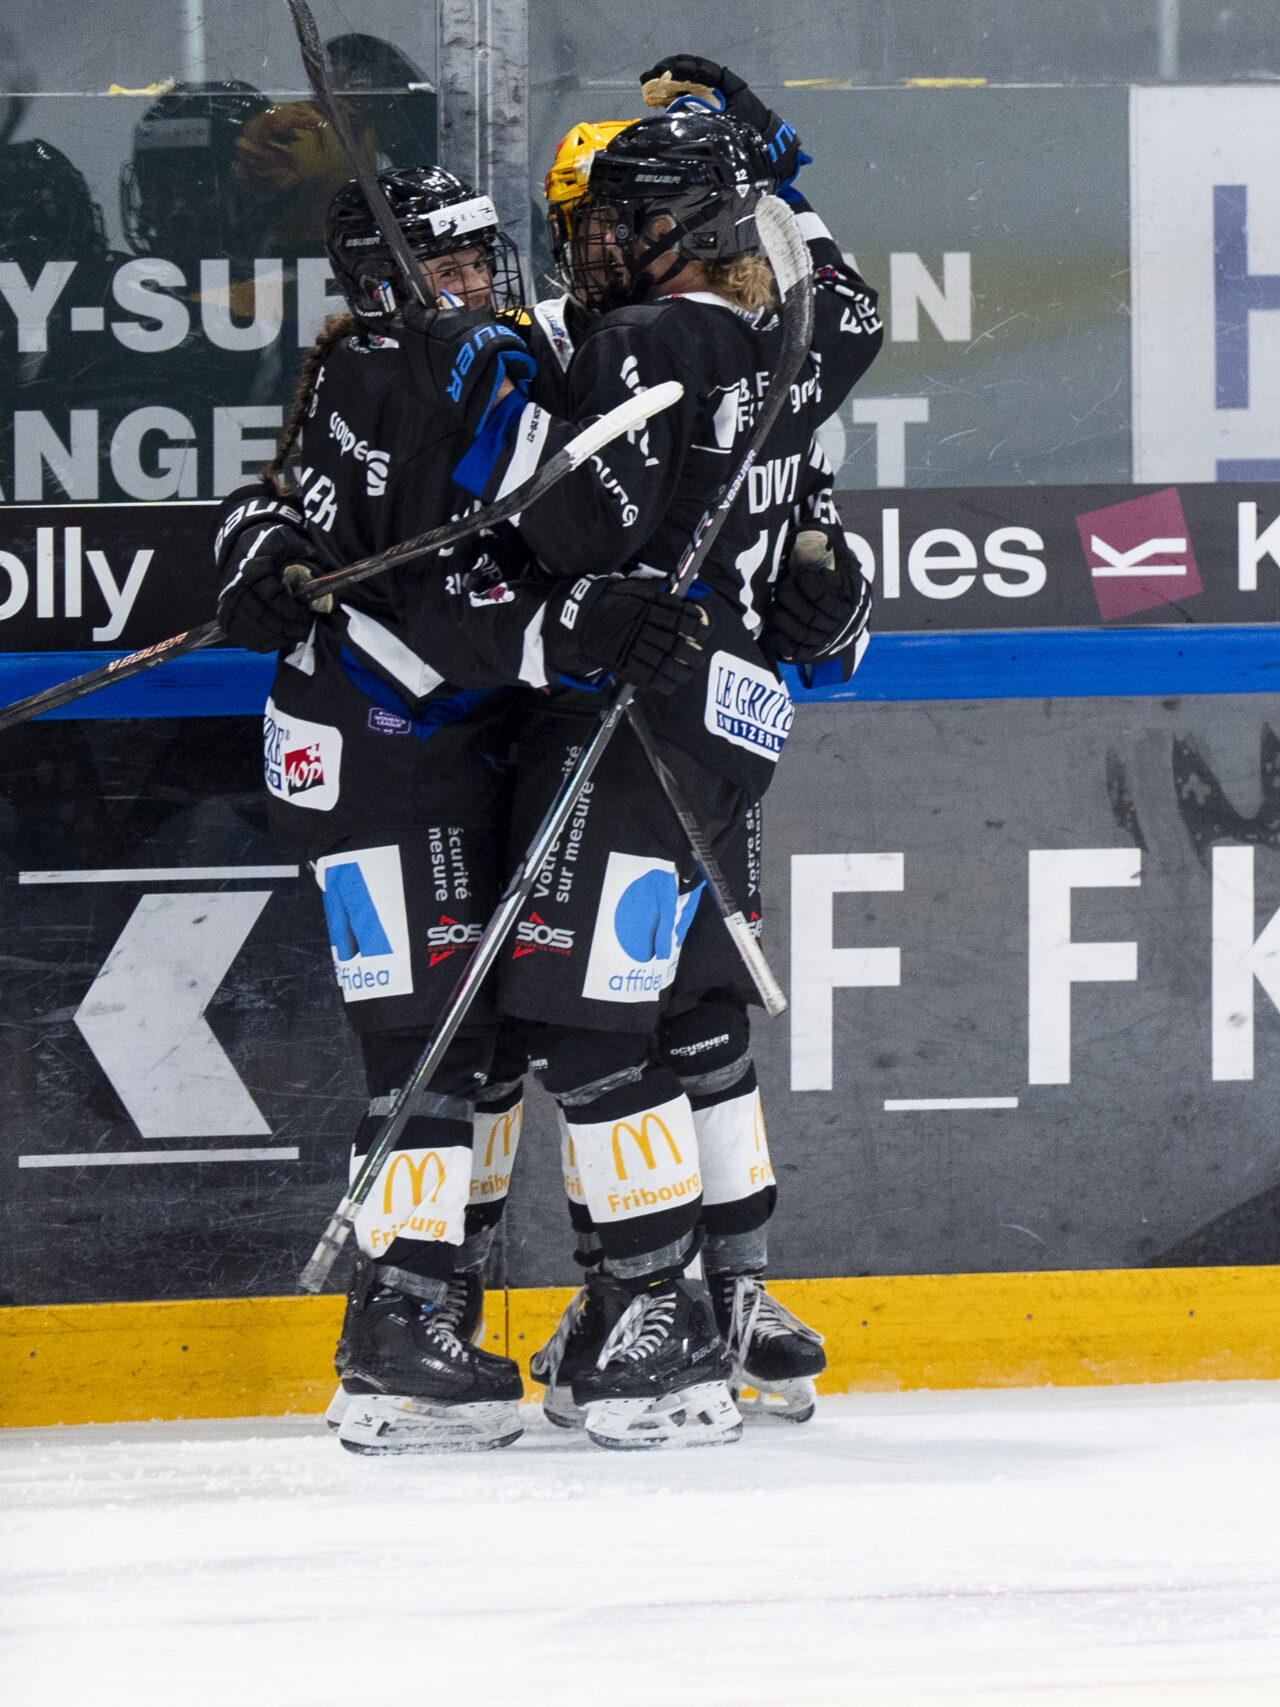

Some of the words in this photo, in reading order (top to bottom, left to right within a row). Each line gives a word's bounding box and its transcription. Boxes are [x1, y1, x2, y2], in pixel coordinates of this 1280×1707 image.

[715, 665, 736, 710] LE
[556, 867, 576, 904] sur
[566, 780, 595, 863] mesure
[516, 920, 576, 950] SOS
[669, 1033, 730, 1056] OCHSNER
[606, 1172, 700, 1214] Fribourg
